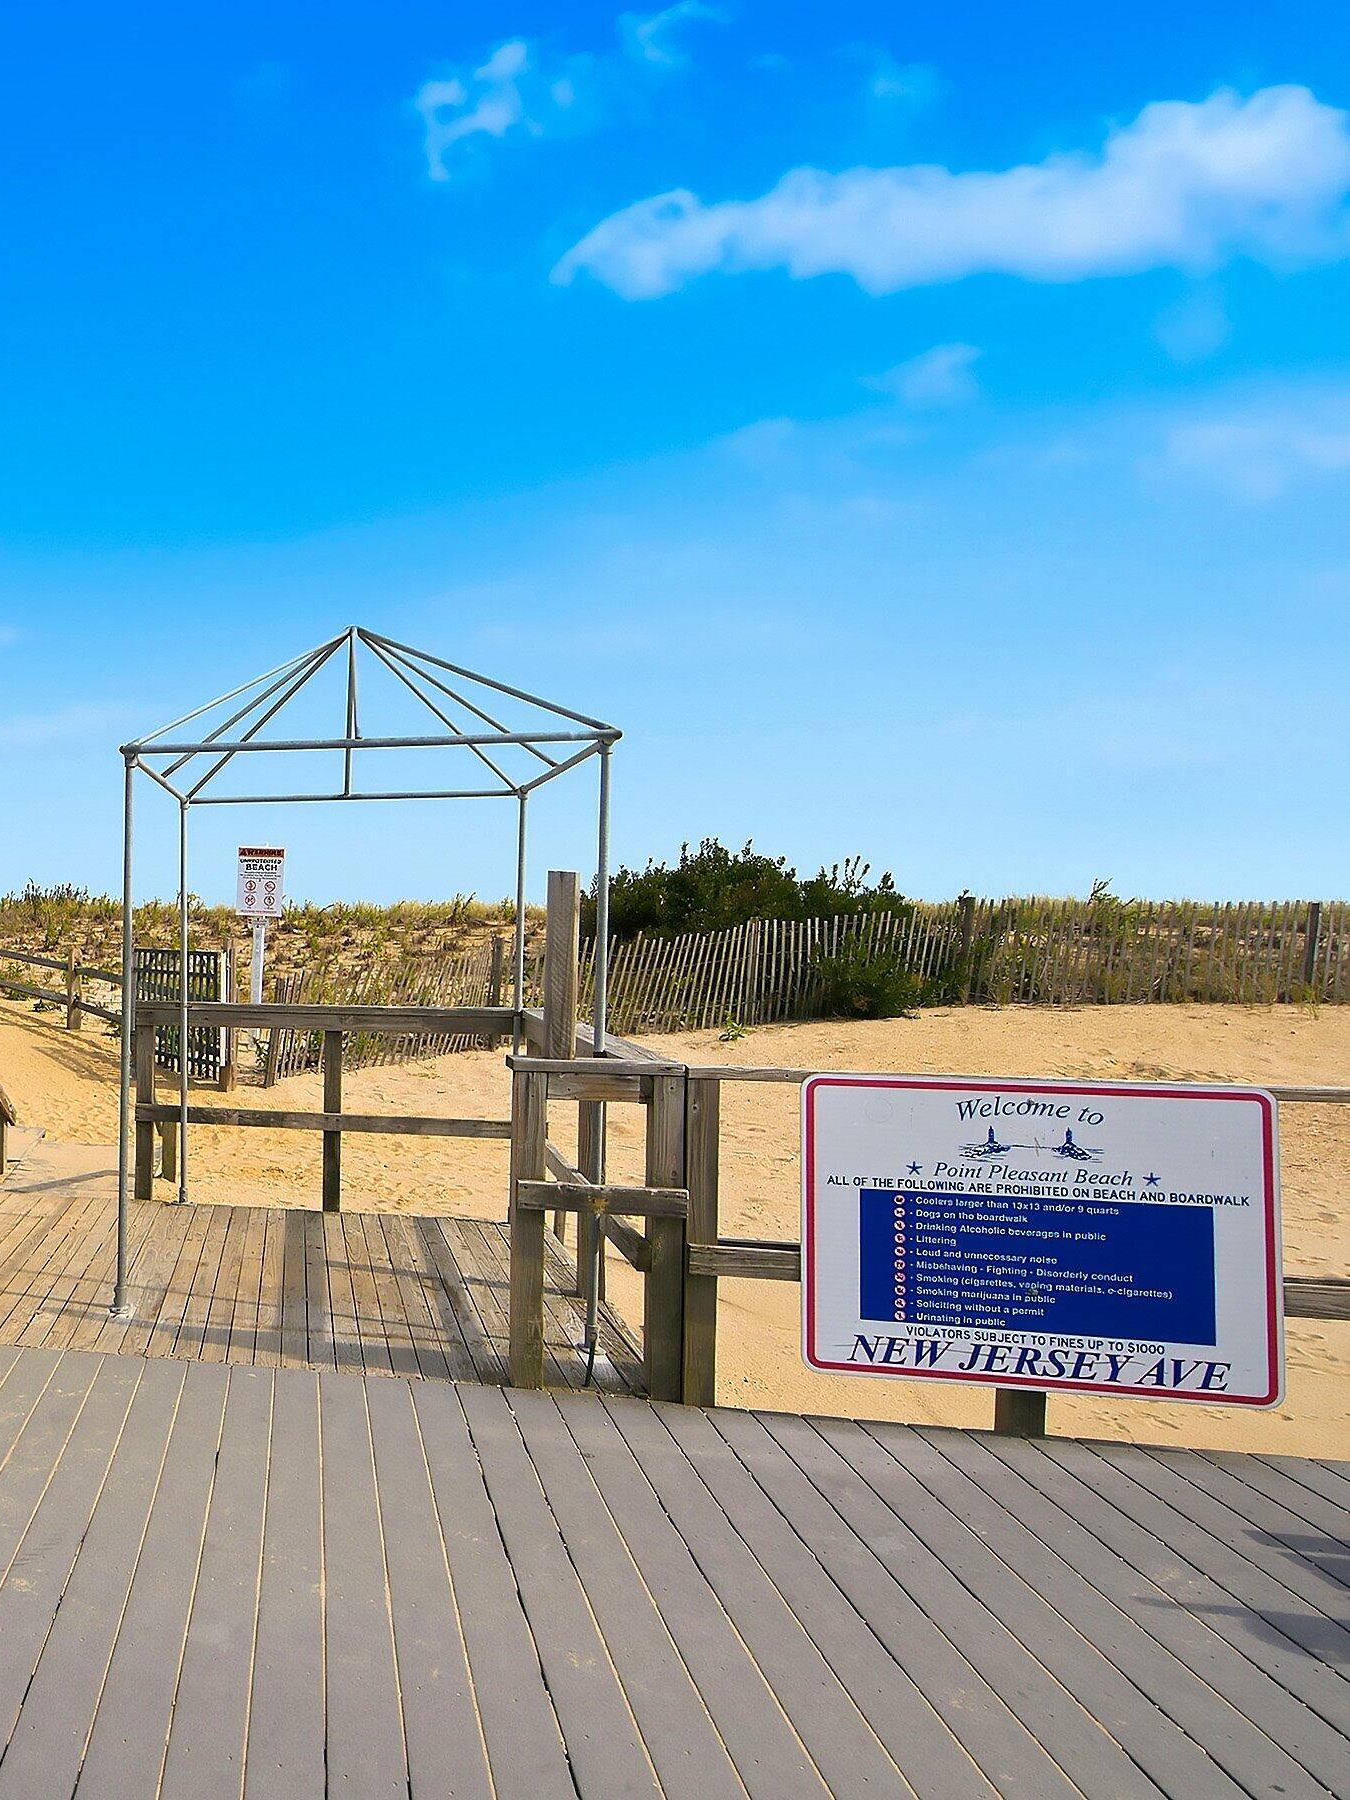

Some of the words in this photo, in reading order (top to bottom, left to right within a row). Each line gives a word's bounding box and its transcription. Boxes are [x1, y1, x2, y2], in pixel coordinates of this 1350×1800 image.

[956, 1096, 1070, 1121] Welcome
[1078, 1106, 1104, 1125] to
[934, 1162, 982, 1179] Point
[988, 1165, 1068, 1183] Pleasant
[1074, 1169, 1133, 1186] Beach
[827, 1175, 849, 1186] ALL
[853, 1177, 867, 1187] OF
[872, 1178, 893, 1188] THE
[898, 1179, 964, 1192] FOLLOWING
[968, 1183, 992, 1193] ARE
[996, 1184, 1069, 1197] PROHIBITED
[1073, 1188, 1090, 1198] ON
[1094, 1189, 1135, 1201] BEACH
[1140, 1191, 1165, 1202] AND
[1170, 1193, 1250, 1206] BOARDWALK
[916, 1197, 953, 1206] Coolers
[955, 1198, 983, 1208] larger
[987, 1200, 1009, 1209] than
[1012, 1202, 1040, 1210] 13x13
[1043, 1204, 1075, 1213] and/or
[1087, 1207, 1119, 1216] quarts
[916, 1210, 941, 1219] Dogs
[959, 1212, 975, 1220] the
[976, 1212, 1028, 1223] boardwalk
[916, 1223, 957, 1233] Drinking
[960, 1225, 1005, 1235] Alcoholic
[1008, 1227, 1060, 1239] beverages
[1062, 1231, 1072, 1239] in
[1075, 1232, 1106, 1241] public
[916, 1236, 957, 1246] Littering
[916, 1248, 940, 1257] Loud
[943, 1250, 961, 1258] and
[964, 1252, 1027, 1263] unnecessary
[1030, 1256, 1057, 1264] noise
[916, 1261, 977, 1273] Misbehaving
[986, 1265, 1027, 1277] Fighting
[1036, 1269, 1088, 1280] Disorderly
[1091, 1273, 1133, 1282] conduct
[916, 1274, 959, 1285] Smoking
[1019, 1281, 1052, 1292] vaping
[1107, 1287, 1173, 1300] e-cigarettes)
[916, 1287, 959, 1298] Smoking
[961, 1290, 1010, 1301] marijuana
[1024, 1295, 1056, 1303] public
[916, 1300, 962, 1311] Soliciting
[964, 1303, 1001, 1313] without
[1012, 1306, 1044, 1316] permit
[916, 1312, 961, 1324] Urinating
[963, 1315, 972, 1324] in
[975, 1316, 1006, 1326] public
[906, 1326, 971, 1340] VIOLATORS
[974, 1331, 1026, 1345] SUBJECT
[1031, 1335, 1046, 1345] TO
[1050, 1336, 1084, 1348] FINES
[1088, 1339, 1104, 1350] UP
[1107, 1341, 1124, 1351] TO
[1127, 1343, 1165, 1355] $1000
[846, 1334, 954, 1368] NEW
[958, 1343, 1134, 1383] JERSEY
[1134, 1357, 1232, 1392] AVE
